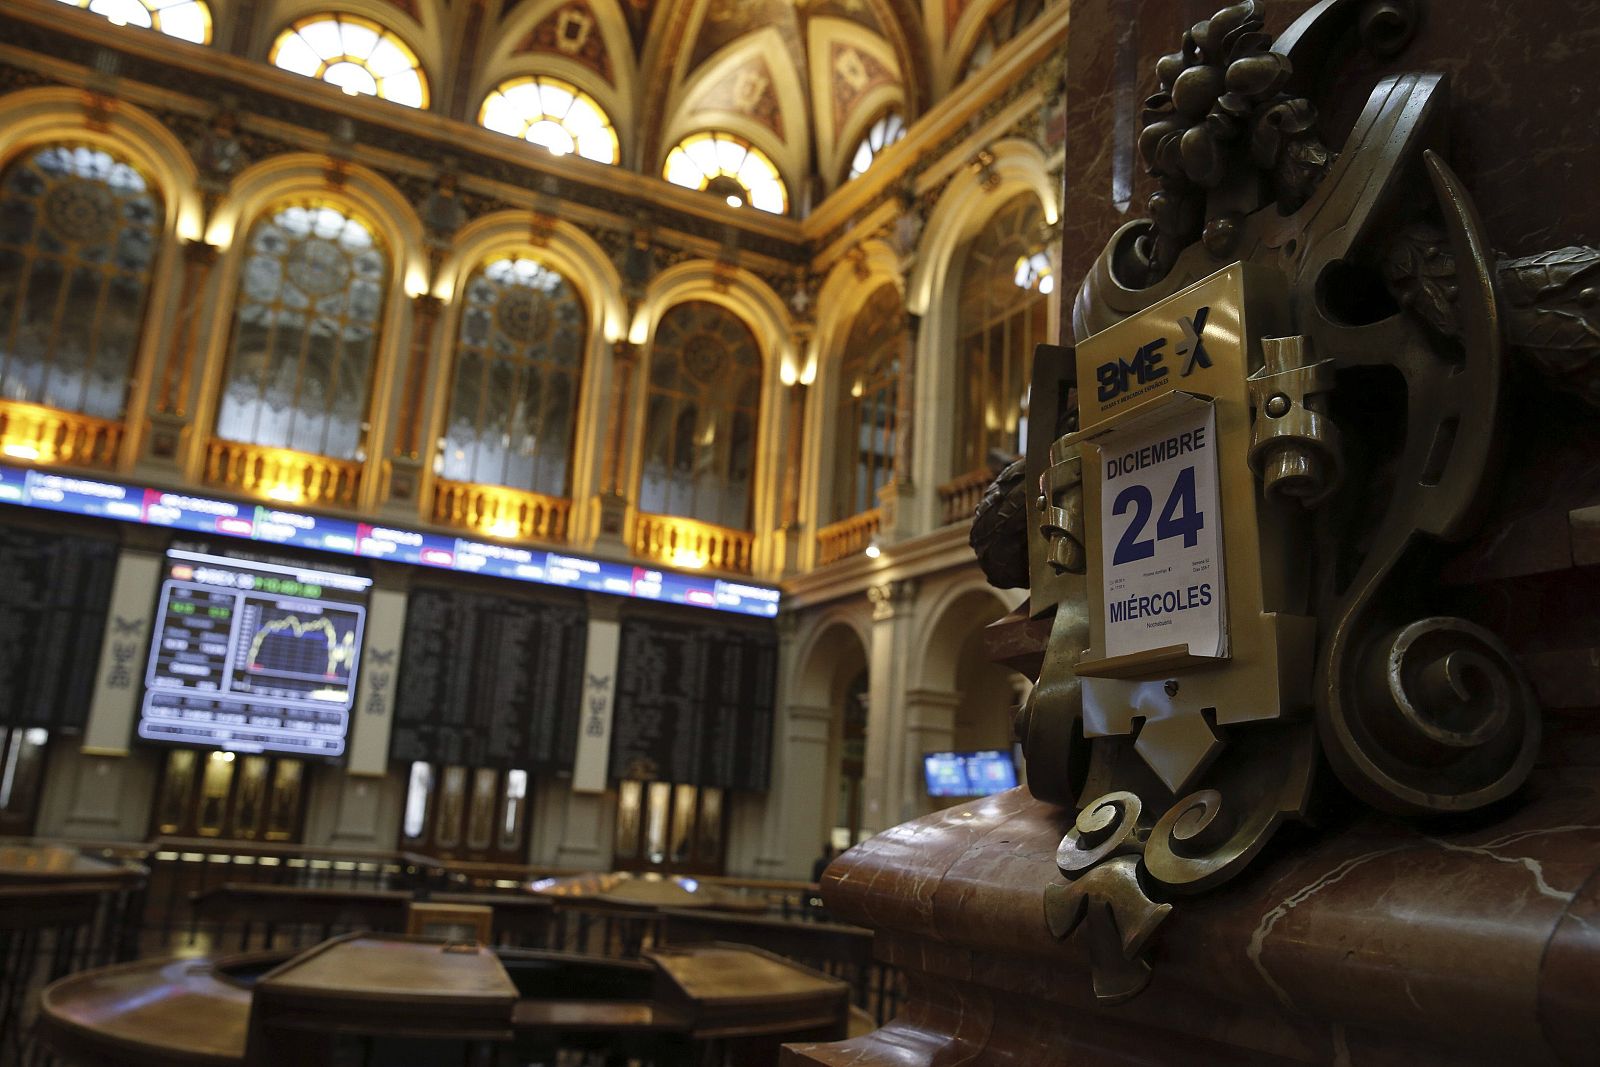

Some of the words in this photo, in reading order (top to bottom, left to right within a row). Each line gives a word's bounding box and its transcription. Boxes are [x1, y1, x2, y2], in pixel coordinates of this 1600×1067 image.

[1097, 338, 1168, 403] BME
[1107, 426, 1206, 480] DICIEMBRE
[1112, 465, 1204, 567] 24
[1110, 583, 1212, 623] MIÉRCOLES
